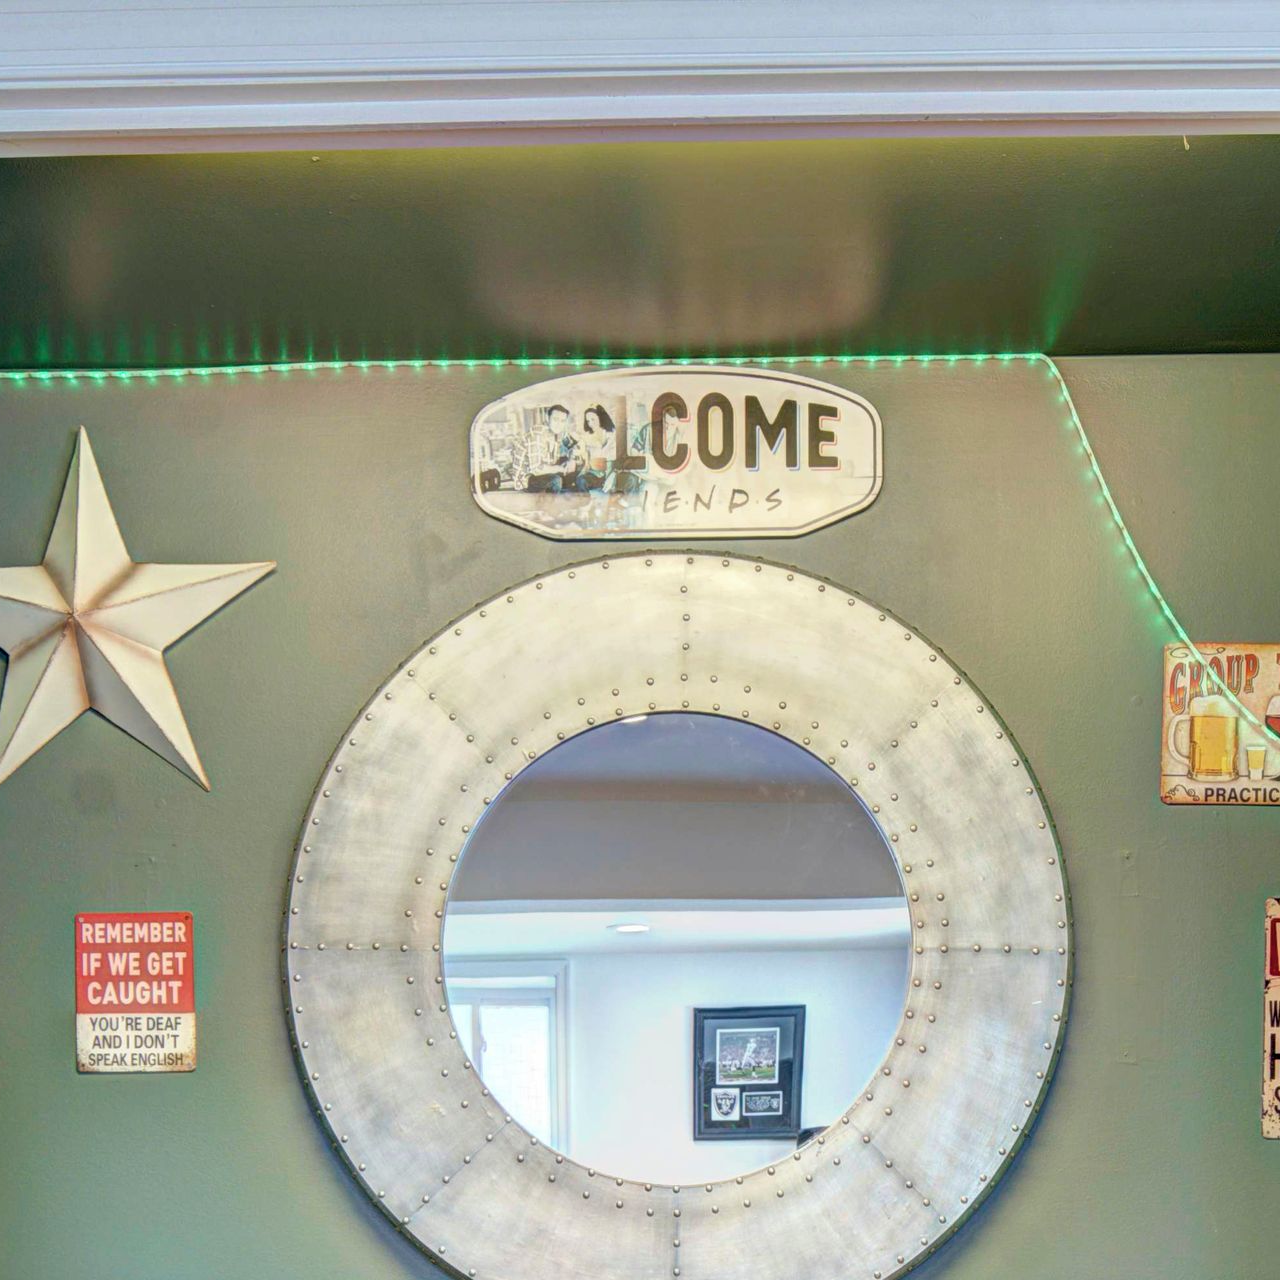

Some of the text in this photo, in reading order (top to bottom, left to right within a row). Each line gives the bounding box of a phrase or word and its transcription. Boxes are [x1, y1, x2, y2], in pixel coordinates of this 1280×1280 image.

[1169, 653, 1260, 715] GROUP
[81, 922, 187, 944] REMEMBER
[82, 952, 187, 977] IF WE GET
[87, 981, 183, 1005] CAUGHT
[89, 1016, 182, 1031] YOU'RE DEAF
[92, 1034, 122, 1049] AND
[134, 1033, 180, 1049] DON'T
[88, 1053, 184, 1067] SPEAK ENGLISH
